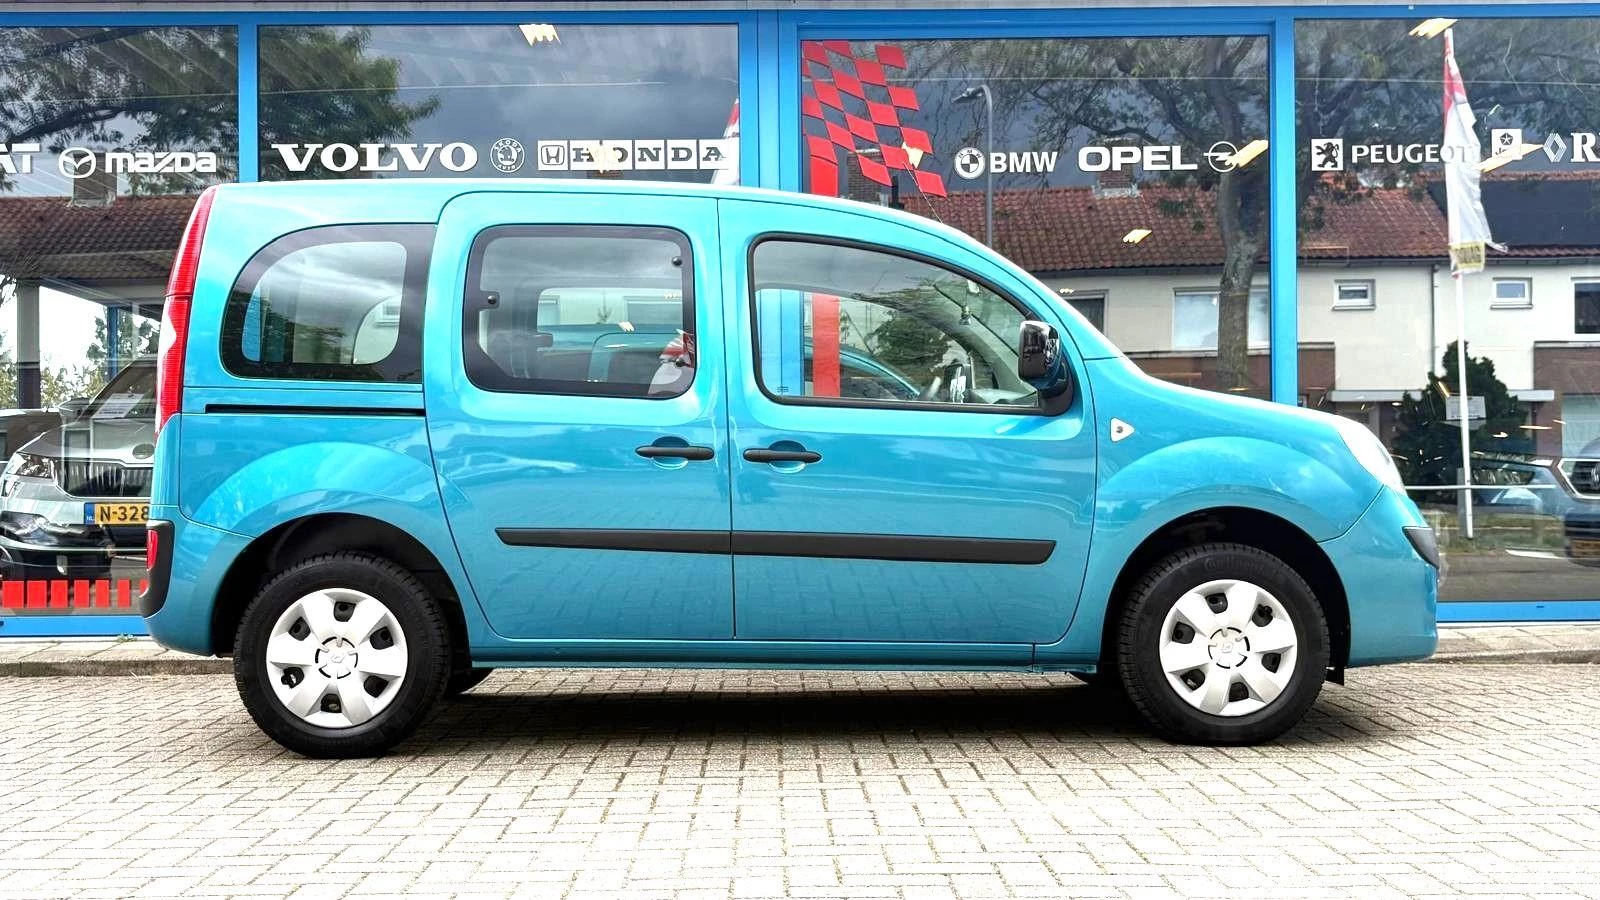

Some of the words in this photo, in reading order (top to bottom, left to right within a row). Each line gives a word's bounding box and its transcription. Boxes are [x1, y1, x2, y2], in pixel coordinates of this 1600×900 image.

[271, 142, 478, 172] VOLVO
[572, 147, 727, 163] HONDA
[1078, 145, 1198, 172] OPEL
[1351, 143, 1473, 164] PEUGEOT
[1570, 132, 1600, 162] R
[990, 152, 1058, 173] BMW
